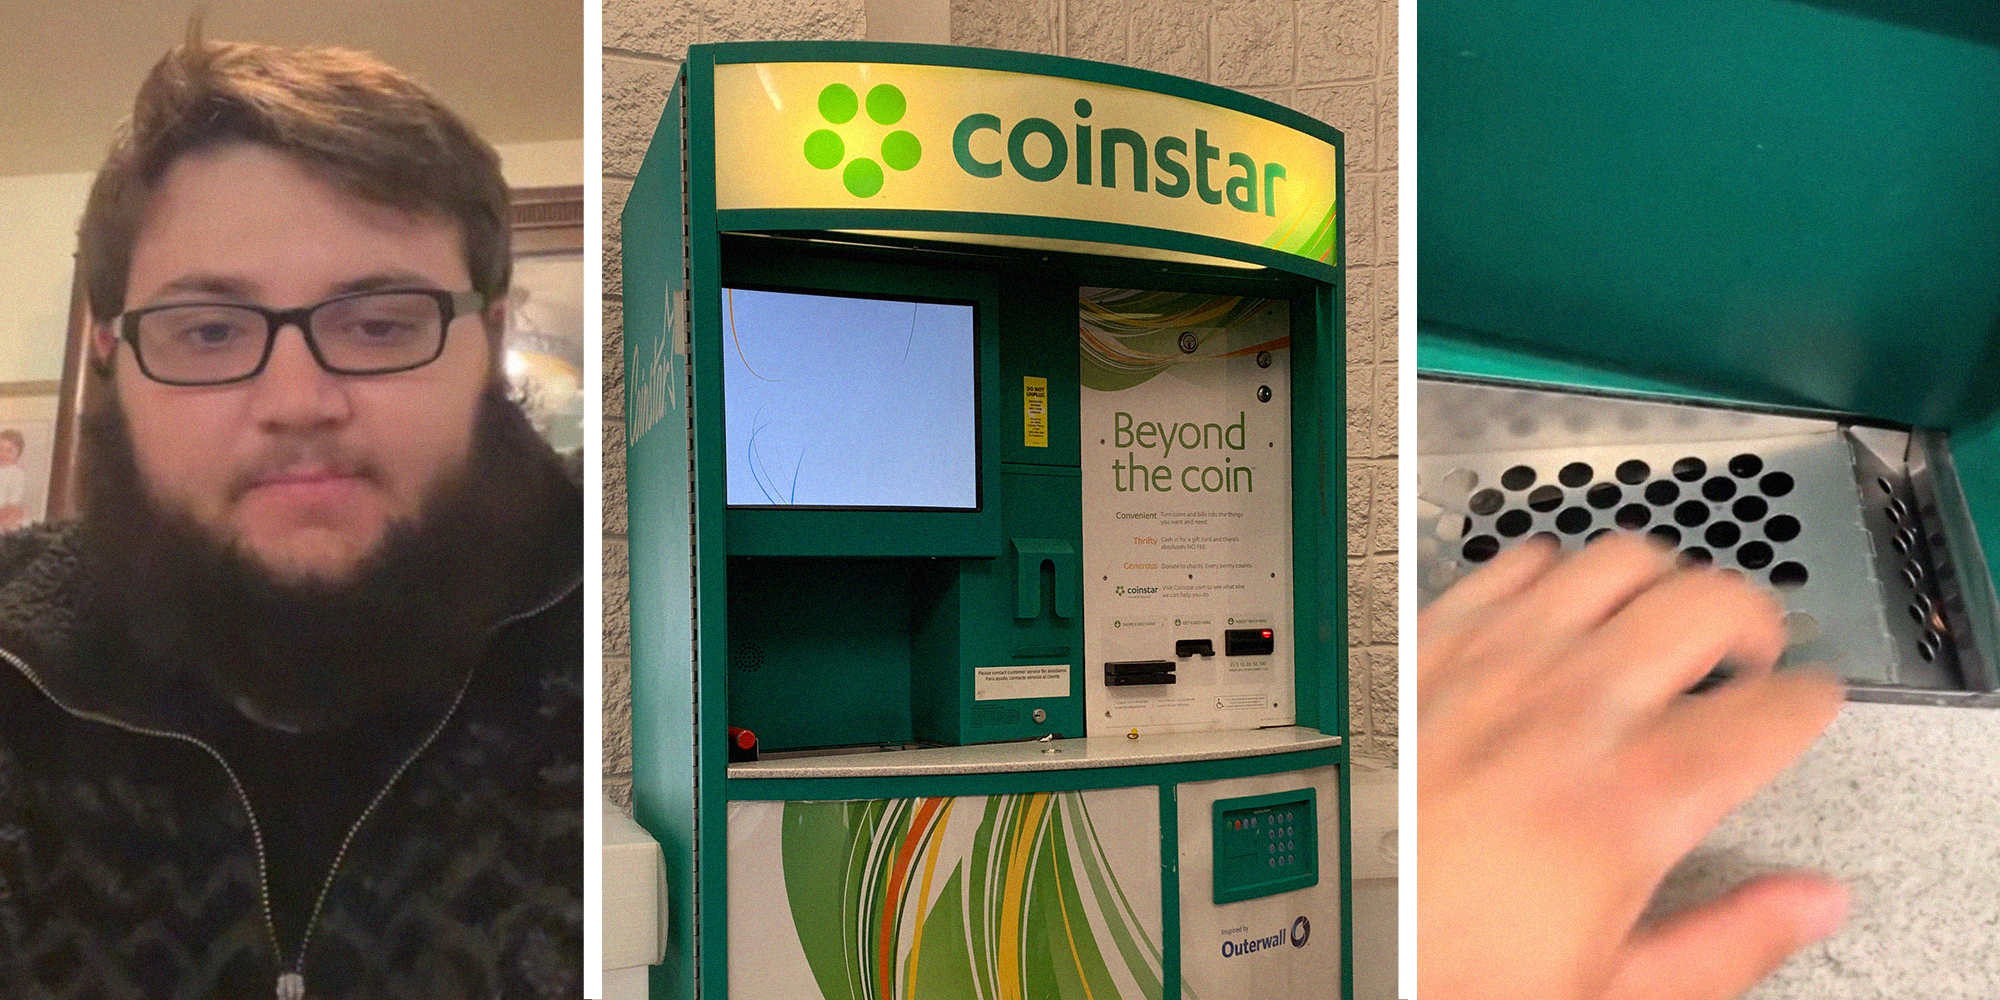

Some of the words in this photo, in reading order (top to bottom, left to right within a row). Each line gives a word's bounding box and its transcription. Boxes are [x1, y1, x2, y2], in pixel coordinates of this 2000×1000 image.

[953, 99, 1286, 217] coinstar
[1114, 411, 1246, 458] Beyond
[1112, 452, 1172, 492] the
[1116, 512, 1157, 520] Convenient
[1134, 537, 1158, 545] Thrifty
[1127, 586, 1158, 594] coinstar
[1221, 926, 1242, 935] Inspired
[1221, 928, 1286, 958] Outerwall
